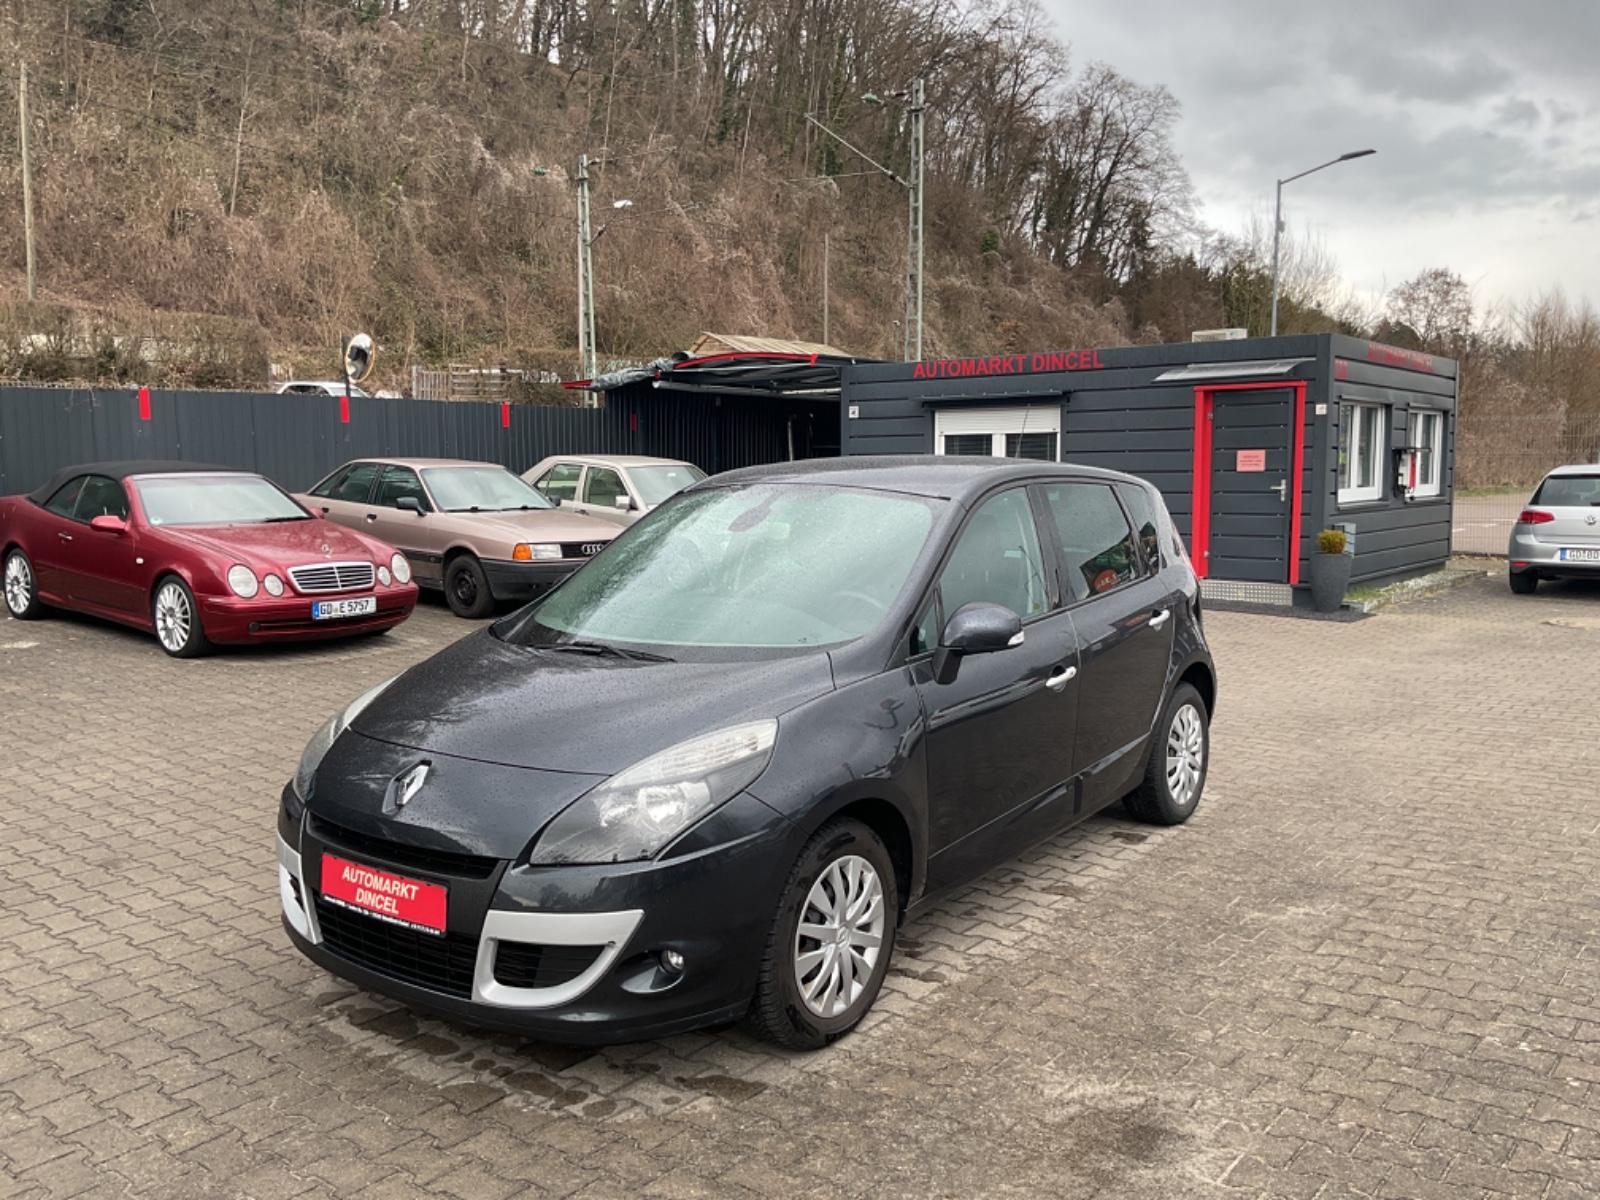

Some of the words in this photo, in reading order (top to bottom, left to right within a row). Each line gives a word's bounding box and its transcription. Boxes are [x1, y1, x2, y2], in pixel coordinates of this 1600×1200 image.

[913, 354, 1026, 380] AUTOMARKT
[1032, 350, 1104, 373] DINCEL
[342, 866, 419, 900] AUTOMARKT
[355, 887, 399, 914] DINCEL
